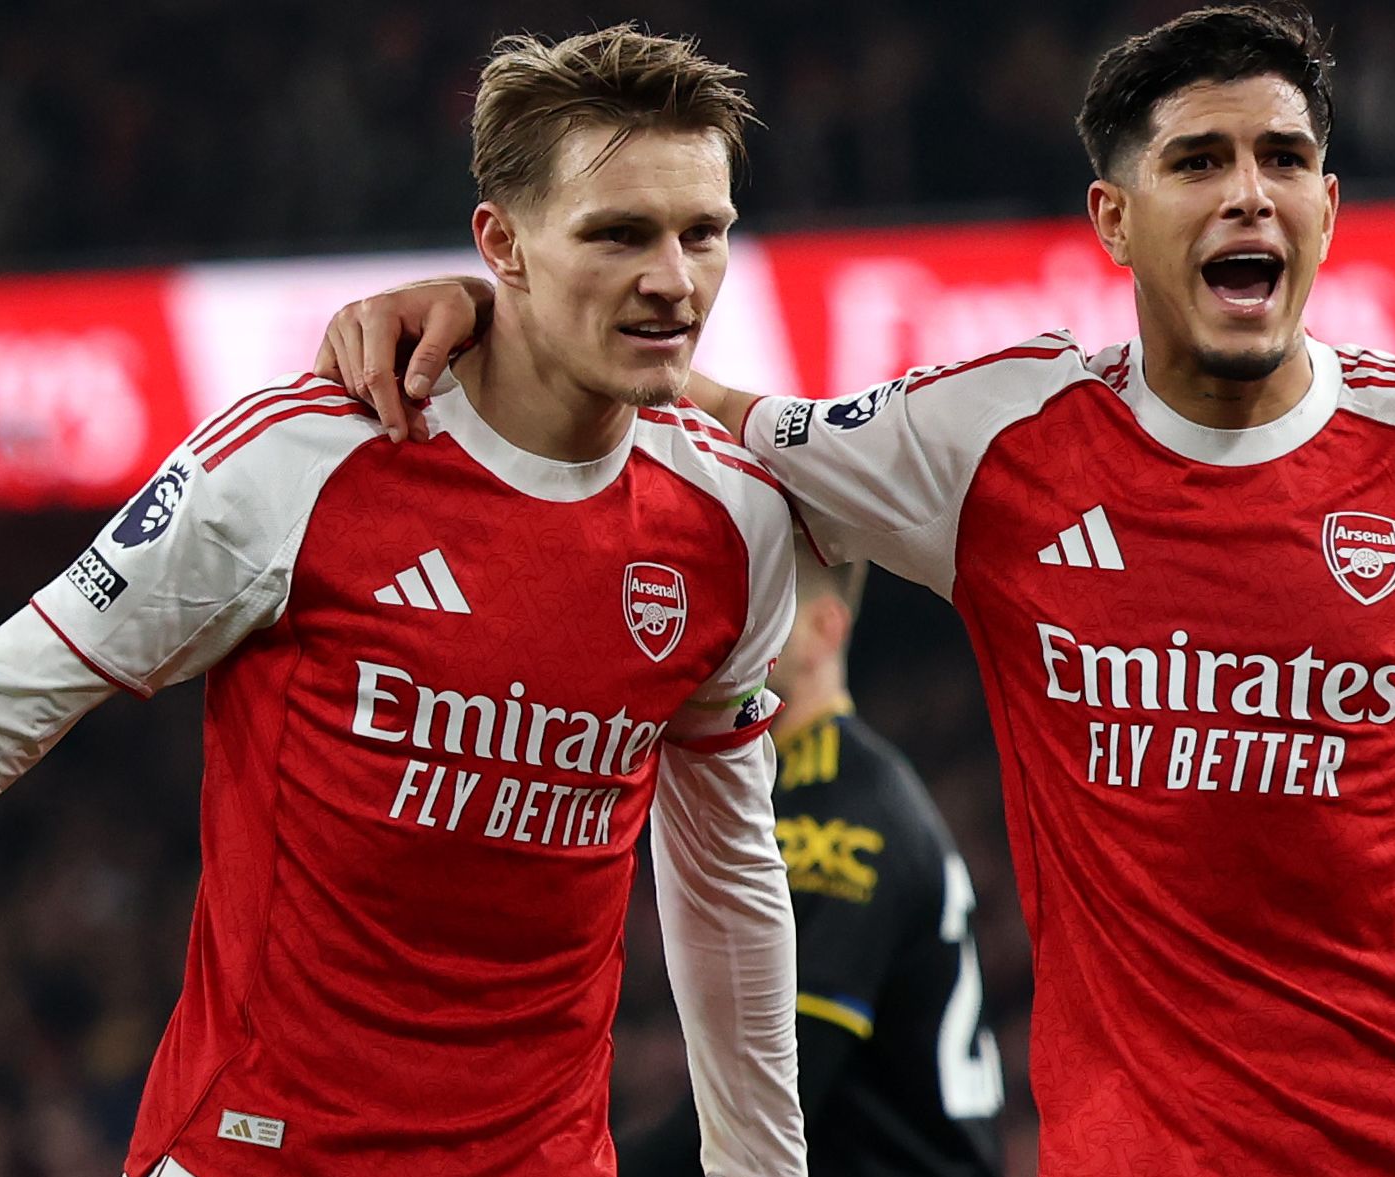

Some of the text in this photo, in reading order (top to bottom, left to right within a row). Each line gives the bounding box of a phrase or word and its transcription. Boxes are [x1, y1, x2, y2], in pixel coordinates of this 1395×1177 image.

[631, 577, 677, 599] Arsenal
[1087, 721, 1346, 797] FLY BETTER
[389, 759, 621, 846] FLY BETTER
